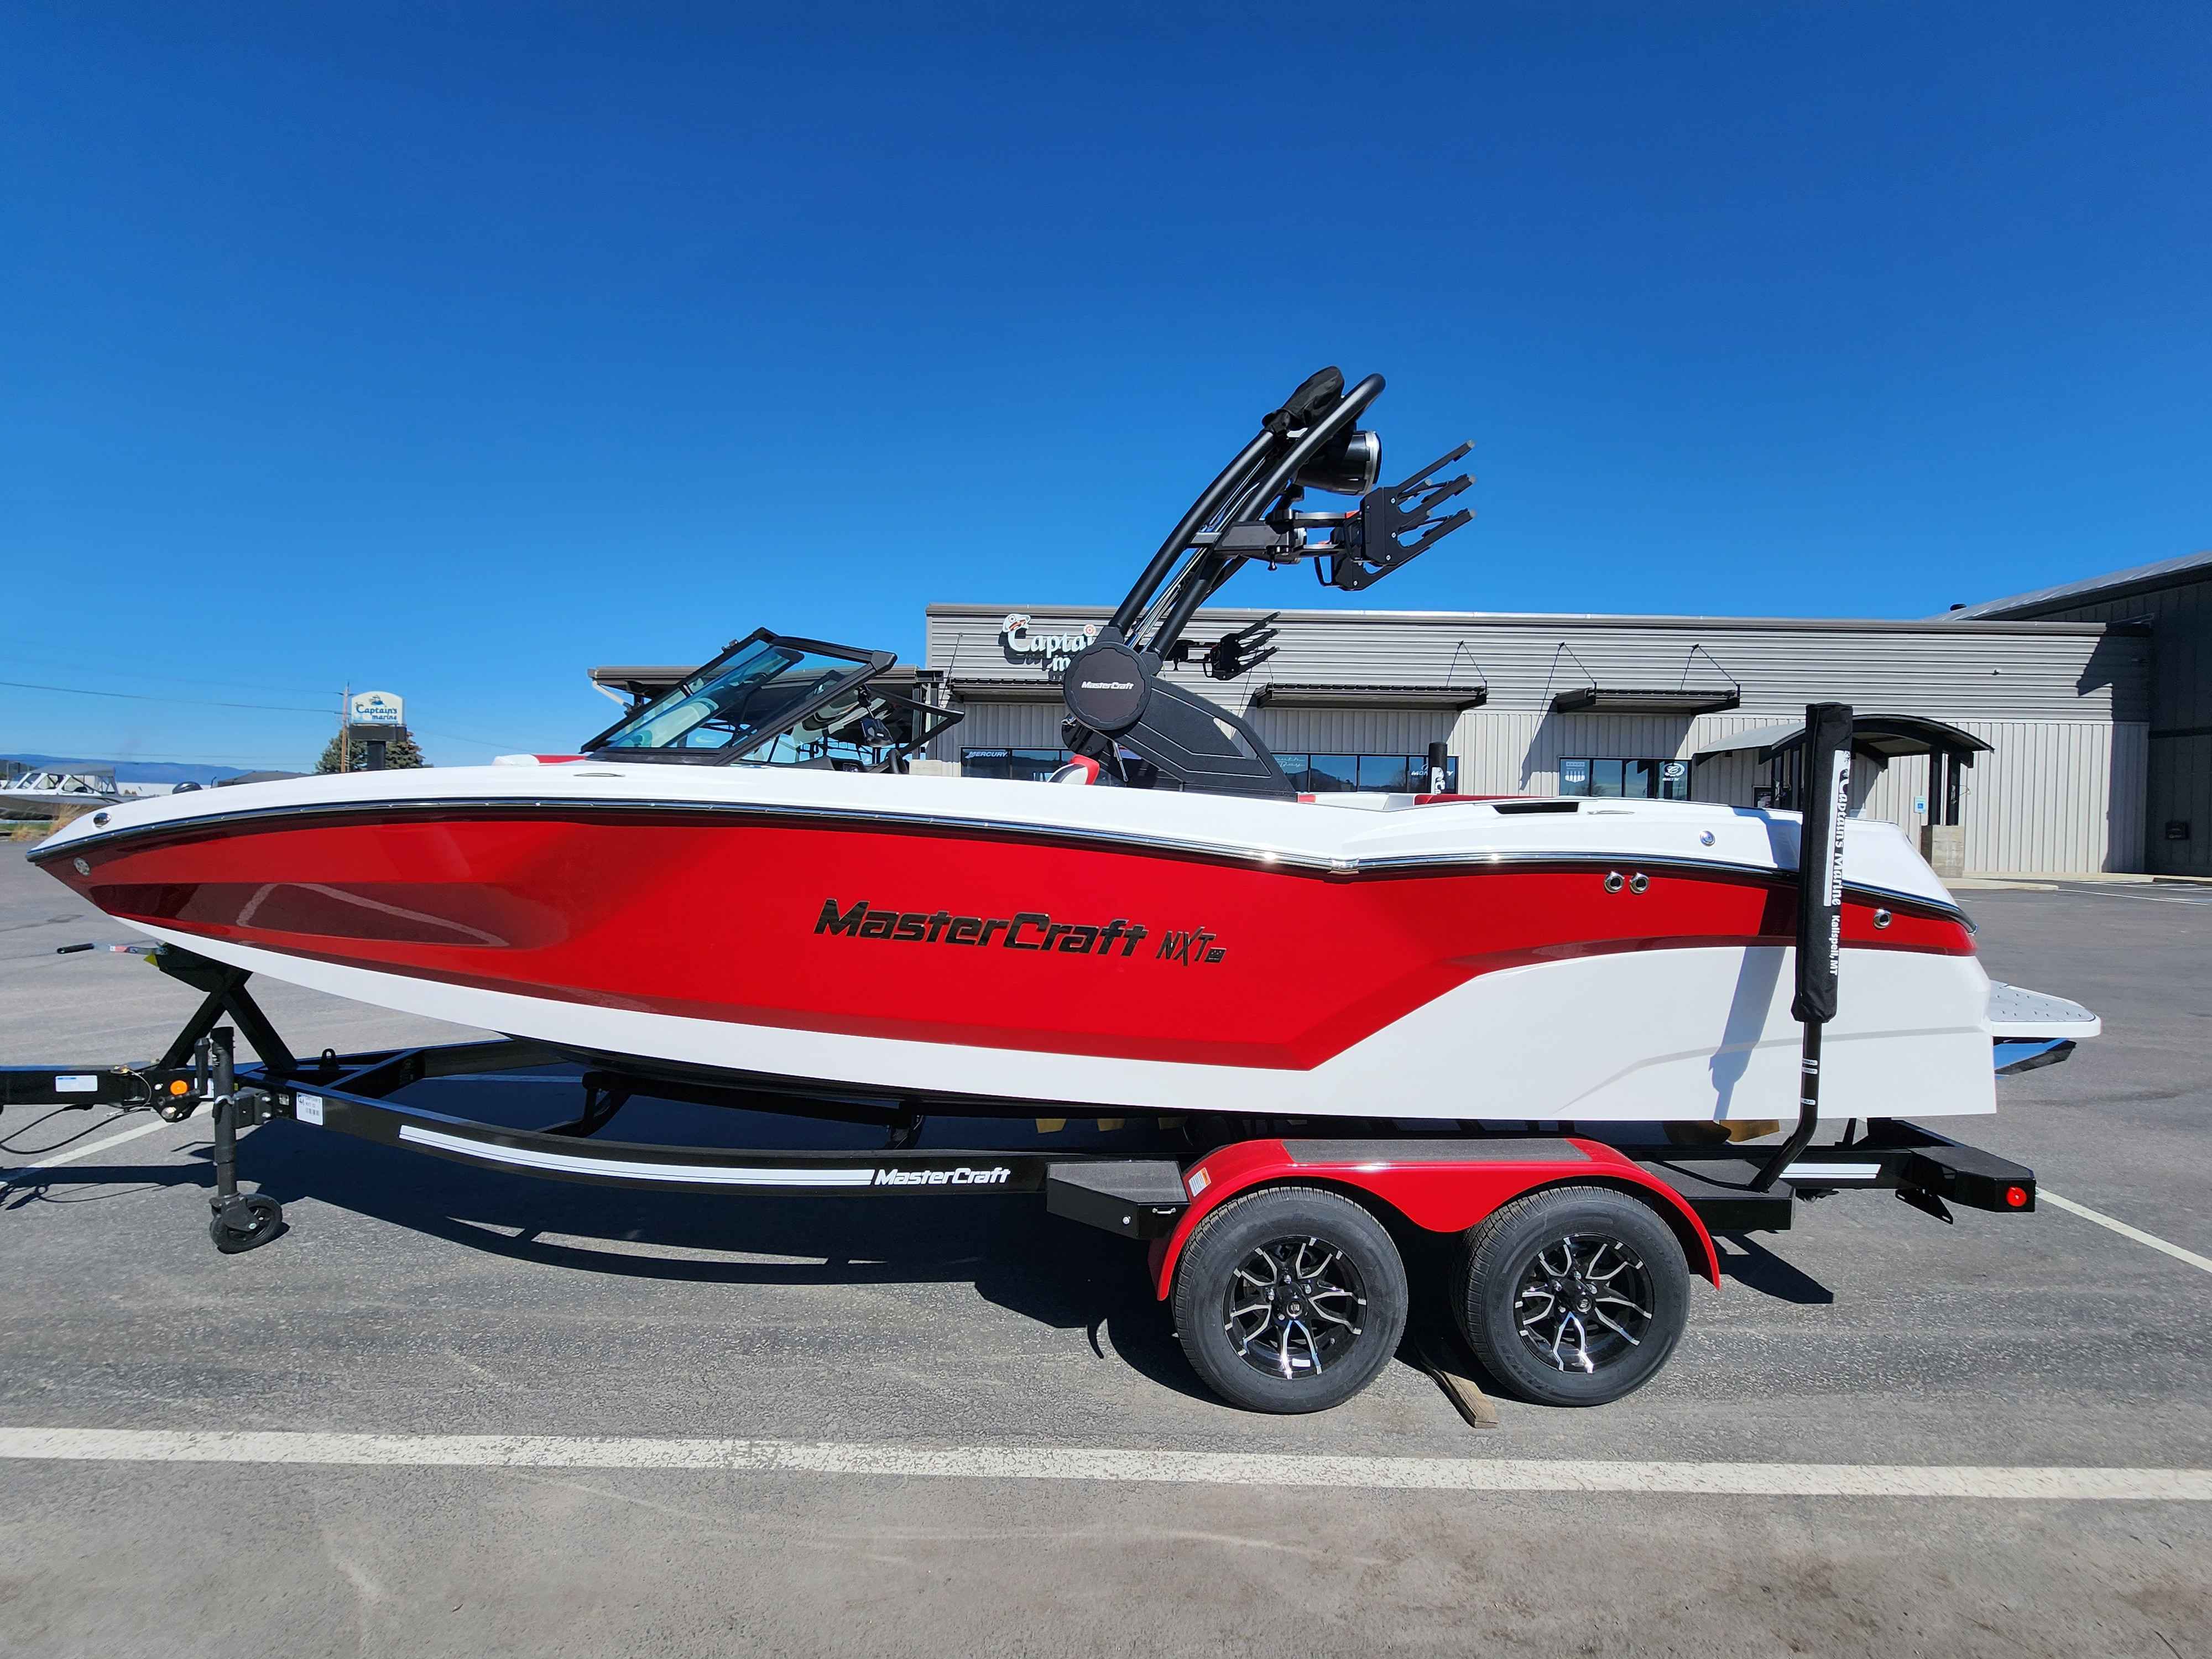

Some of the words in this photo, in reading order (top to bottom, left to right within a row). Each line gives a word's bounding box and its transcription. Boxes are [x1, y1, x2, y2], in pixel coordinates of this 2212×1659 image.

[1081, 681, 1134, 690] MasterCraft
[1832, 853, 1844, 906] Marine
[813, 898, 1149, 957] MasterCraft
[1155, 926, 1216, 967] NXT
[1829, 915, 1840, 959] Kalispell,
[1829, 959, 1838, 976] MT
[874, 1167, 1010, 1185] MasterCraft
